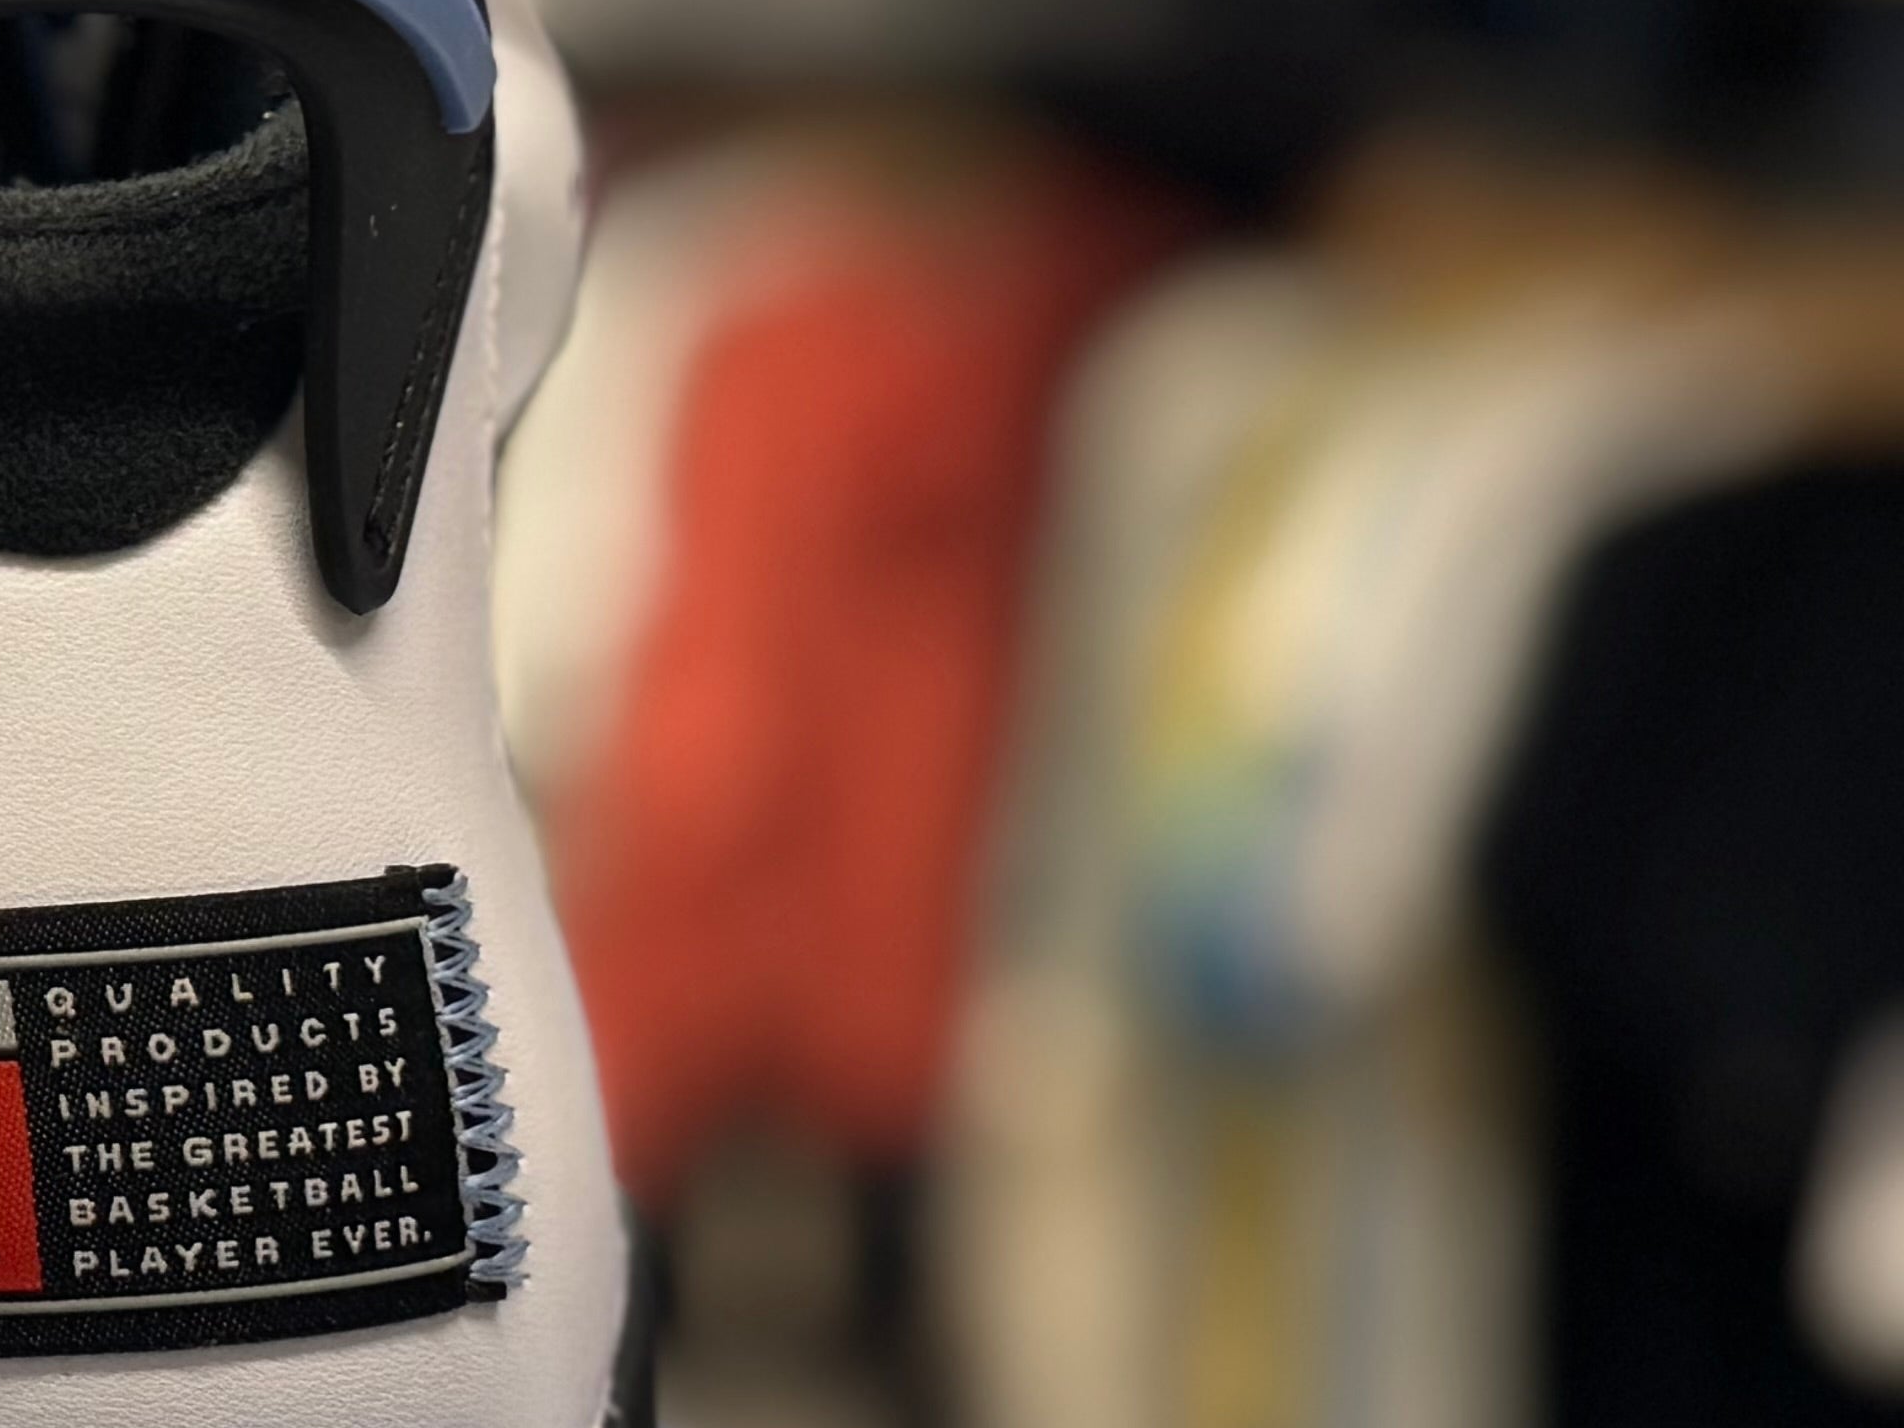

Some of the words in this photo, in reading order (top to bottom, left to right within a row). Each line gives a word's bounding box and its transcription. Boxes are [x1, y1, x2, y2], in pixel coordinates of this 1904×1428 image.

[43, 954, 387, 1019] QUALITY
[49, 1006, 399, 1069] PRODUCTS
[57, 1070, 330, 1123] INSPIRED
[358, 1056, 407, 1094] BY
[62, 1140, 155, 1173] THE
[182, 1109, 414, 1167] GREATEST
[68, 1164, 420, 1228] BASKETBALL
[72, 1235, 282, 1277] PLAYER
[310, 1215, 433, 1261] EVER.
